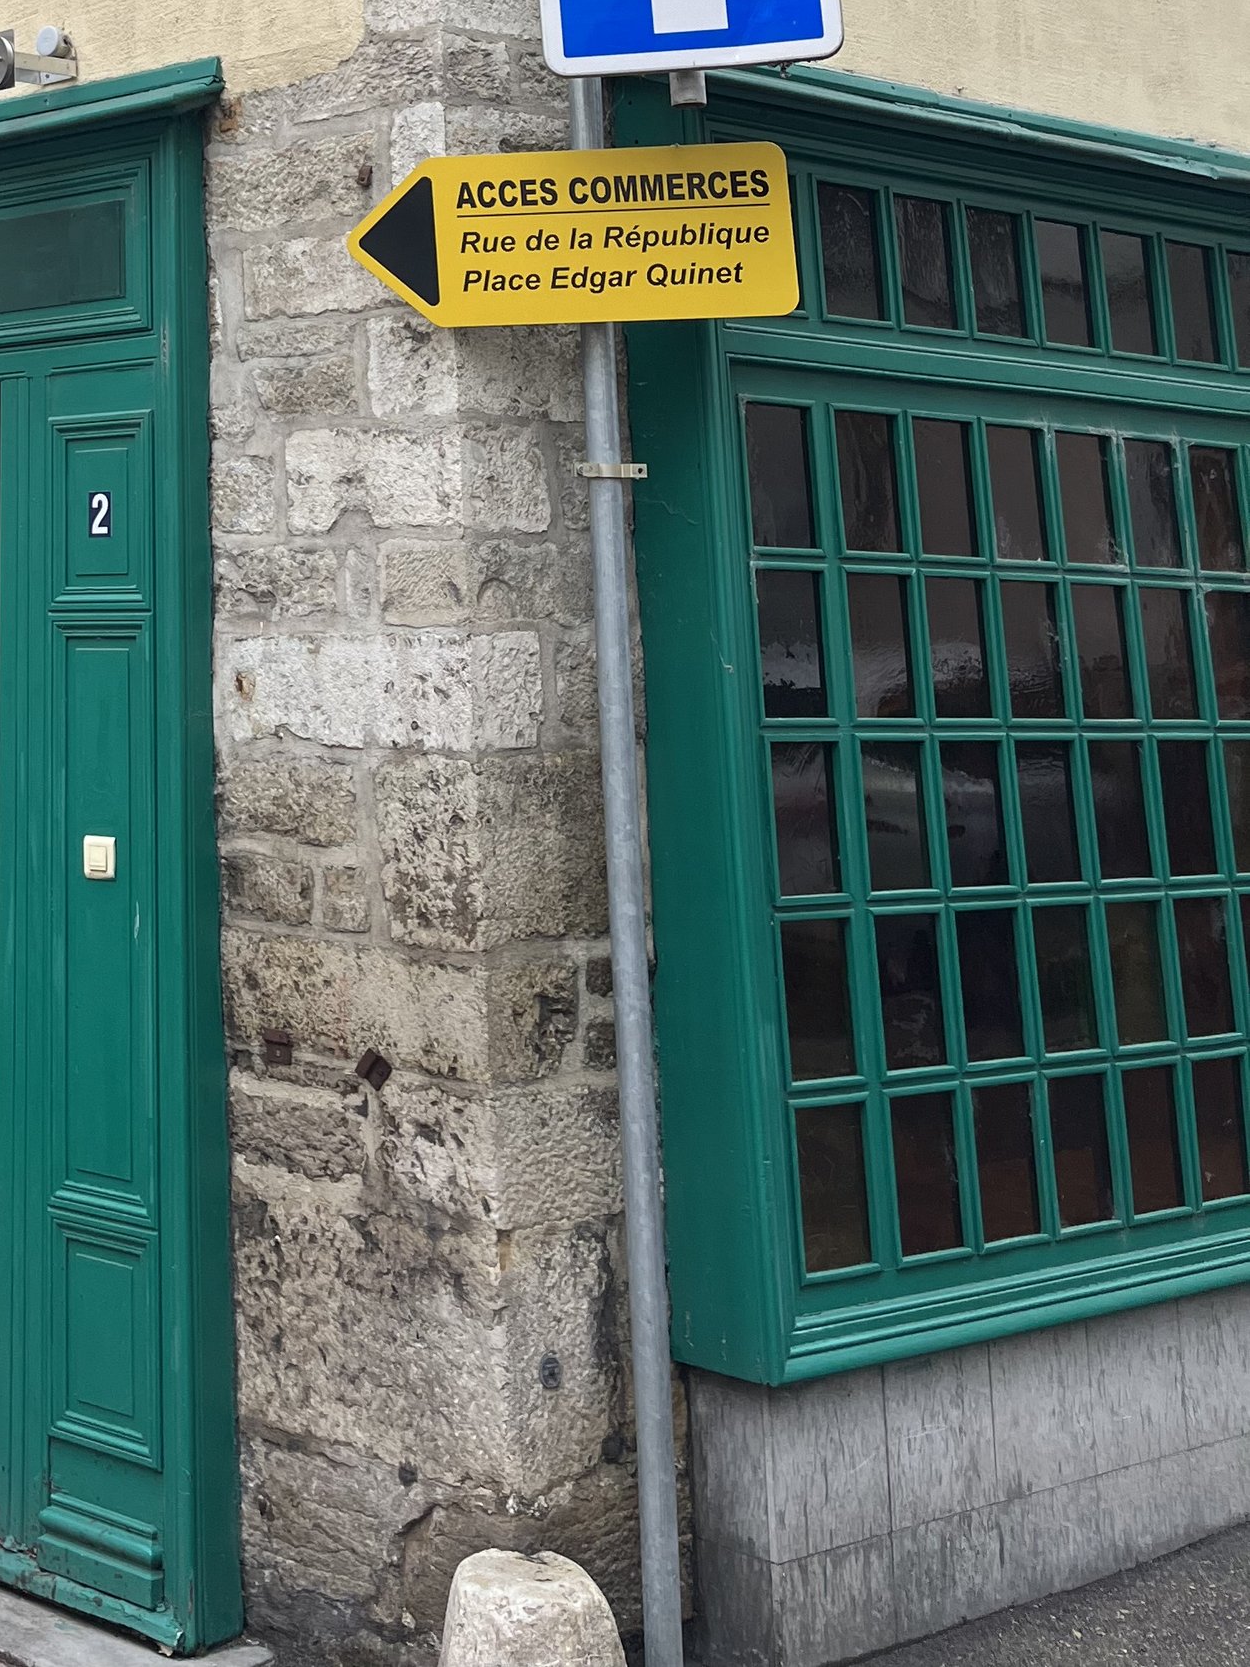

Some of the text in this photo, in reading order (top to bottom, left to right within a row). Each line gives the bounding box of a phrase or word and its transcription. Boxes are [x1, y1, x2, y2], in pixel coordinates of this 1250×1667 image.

[456, 170, 769, 209] ACCES COMMERCES
[460, 222, 770, 254] Rue de la République
[463, 261, 744, 294] Place Edgar Quinet
[92, 493, 108, 534] 2
